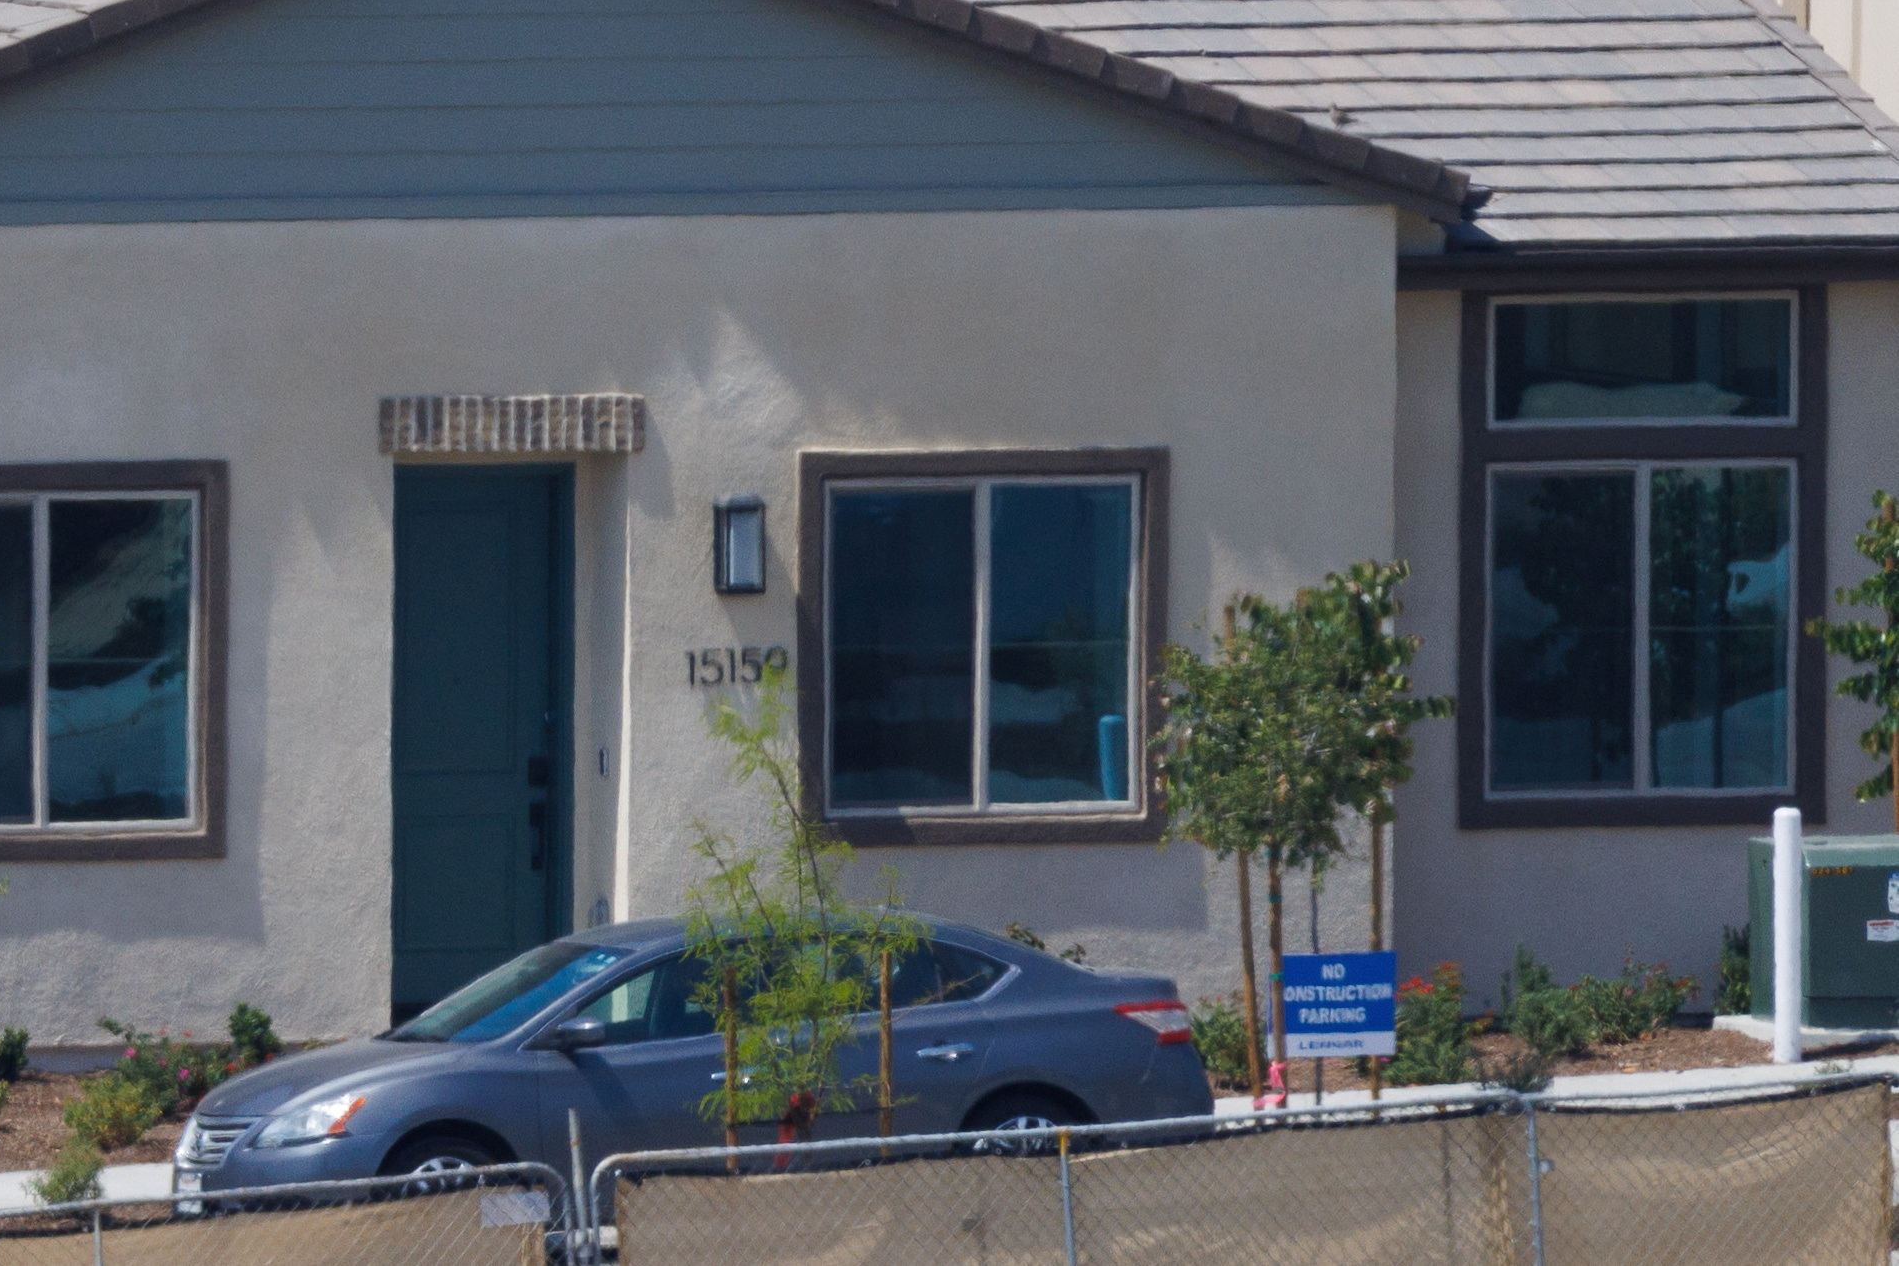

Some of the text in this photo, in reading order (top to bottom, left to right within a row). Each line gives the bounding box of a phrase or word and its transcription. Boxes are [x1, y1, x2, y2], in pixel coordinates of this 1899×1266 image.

[1321, 963, 1345, 980] NO
[1284, 983, 1392, 1002] ONSTRUCTION
[1299, 1007, 1366, 1024] PARKING
